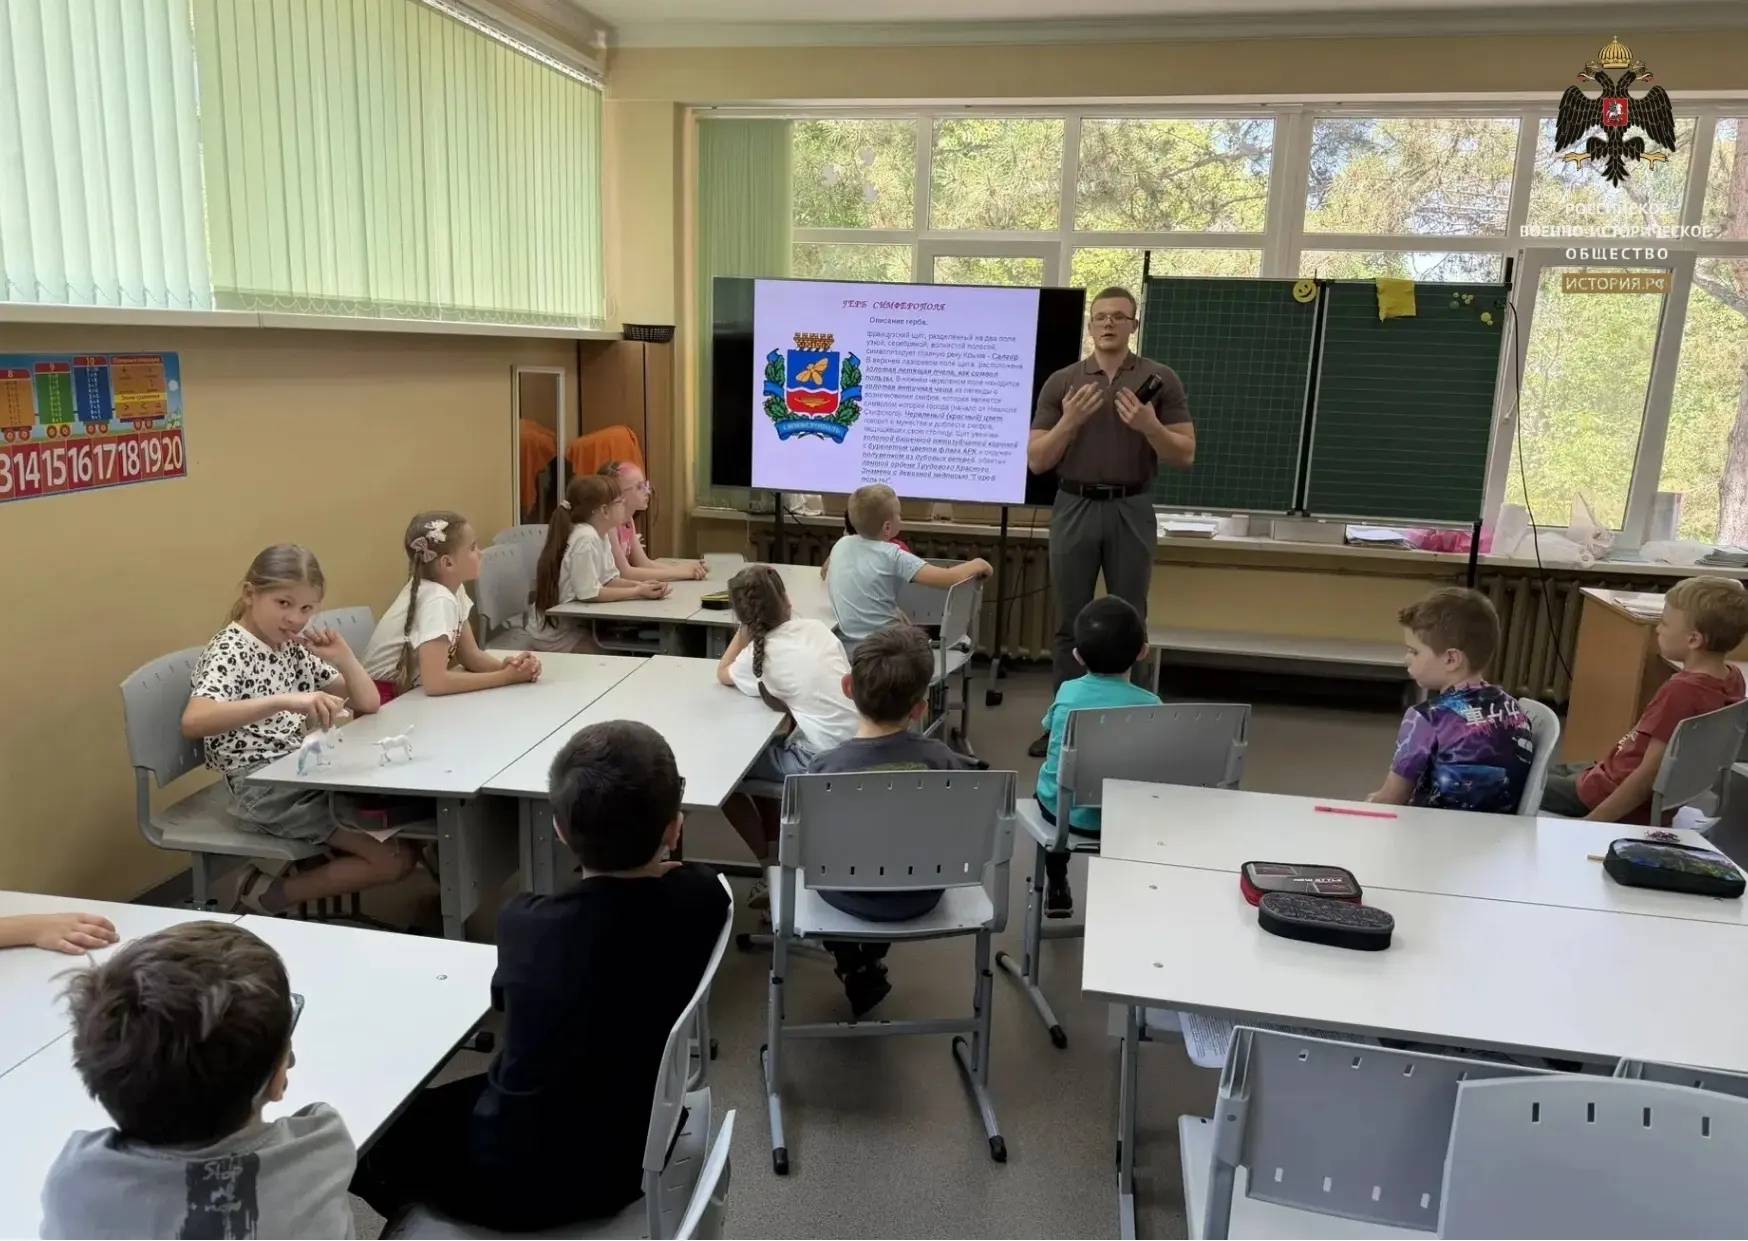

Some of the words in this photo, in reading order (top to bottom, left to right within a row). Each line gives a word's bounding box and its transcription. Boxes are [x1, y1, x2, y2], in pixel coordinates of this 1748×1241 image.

[842, 300, 868, 308] ГЕРБ
[872, 301, 946, 311] СИМФЕРОПОЛЯ
[13, 450, 41, 491] 14
[41, 448, 67, 487] 15
[68, 445, 93, 483] 16
[93, 443, 117, 480] 17
[118, 440, 140, 477] 18
[140, 437, 162, 473] 19
[162, 435, 183, 471] 20
